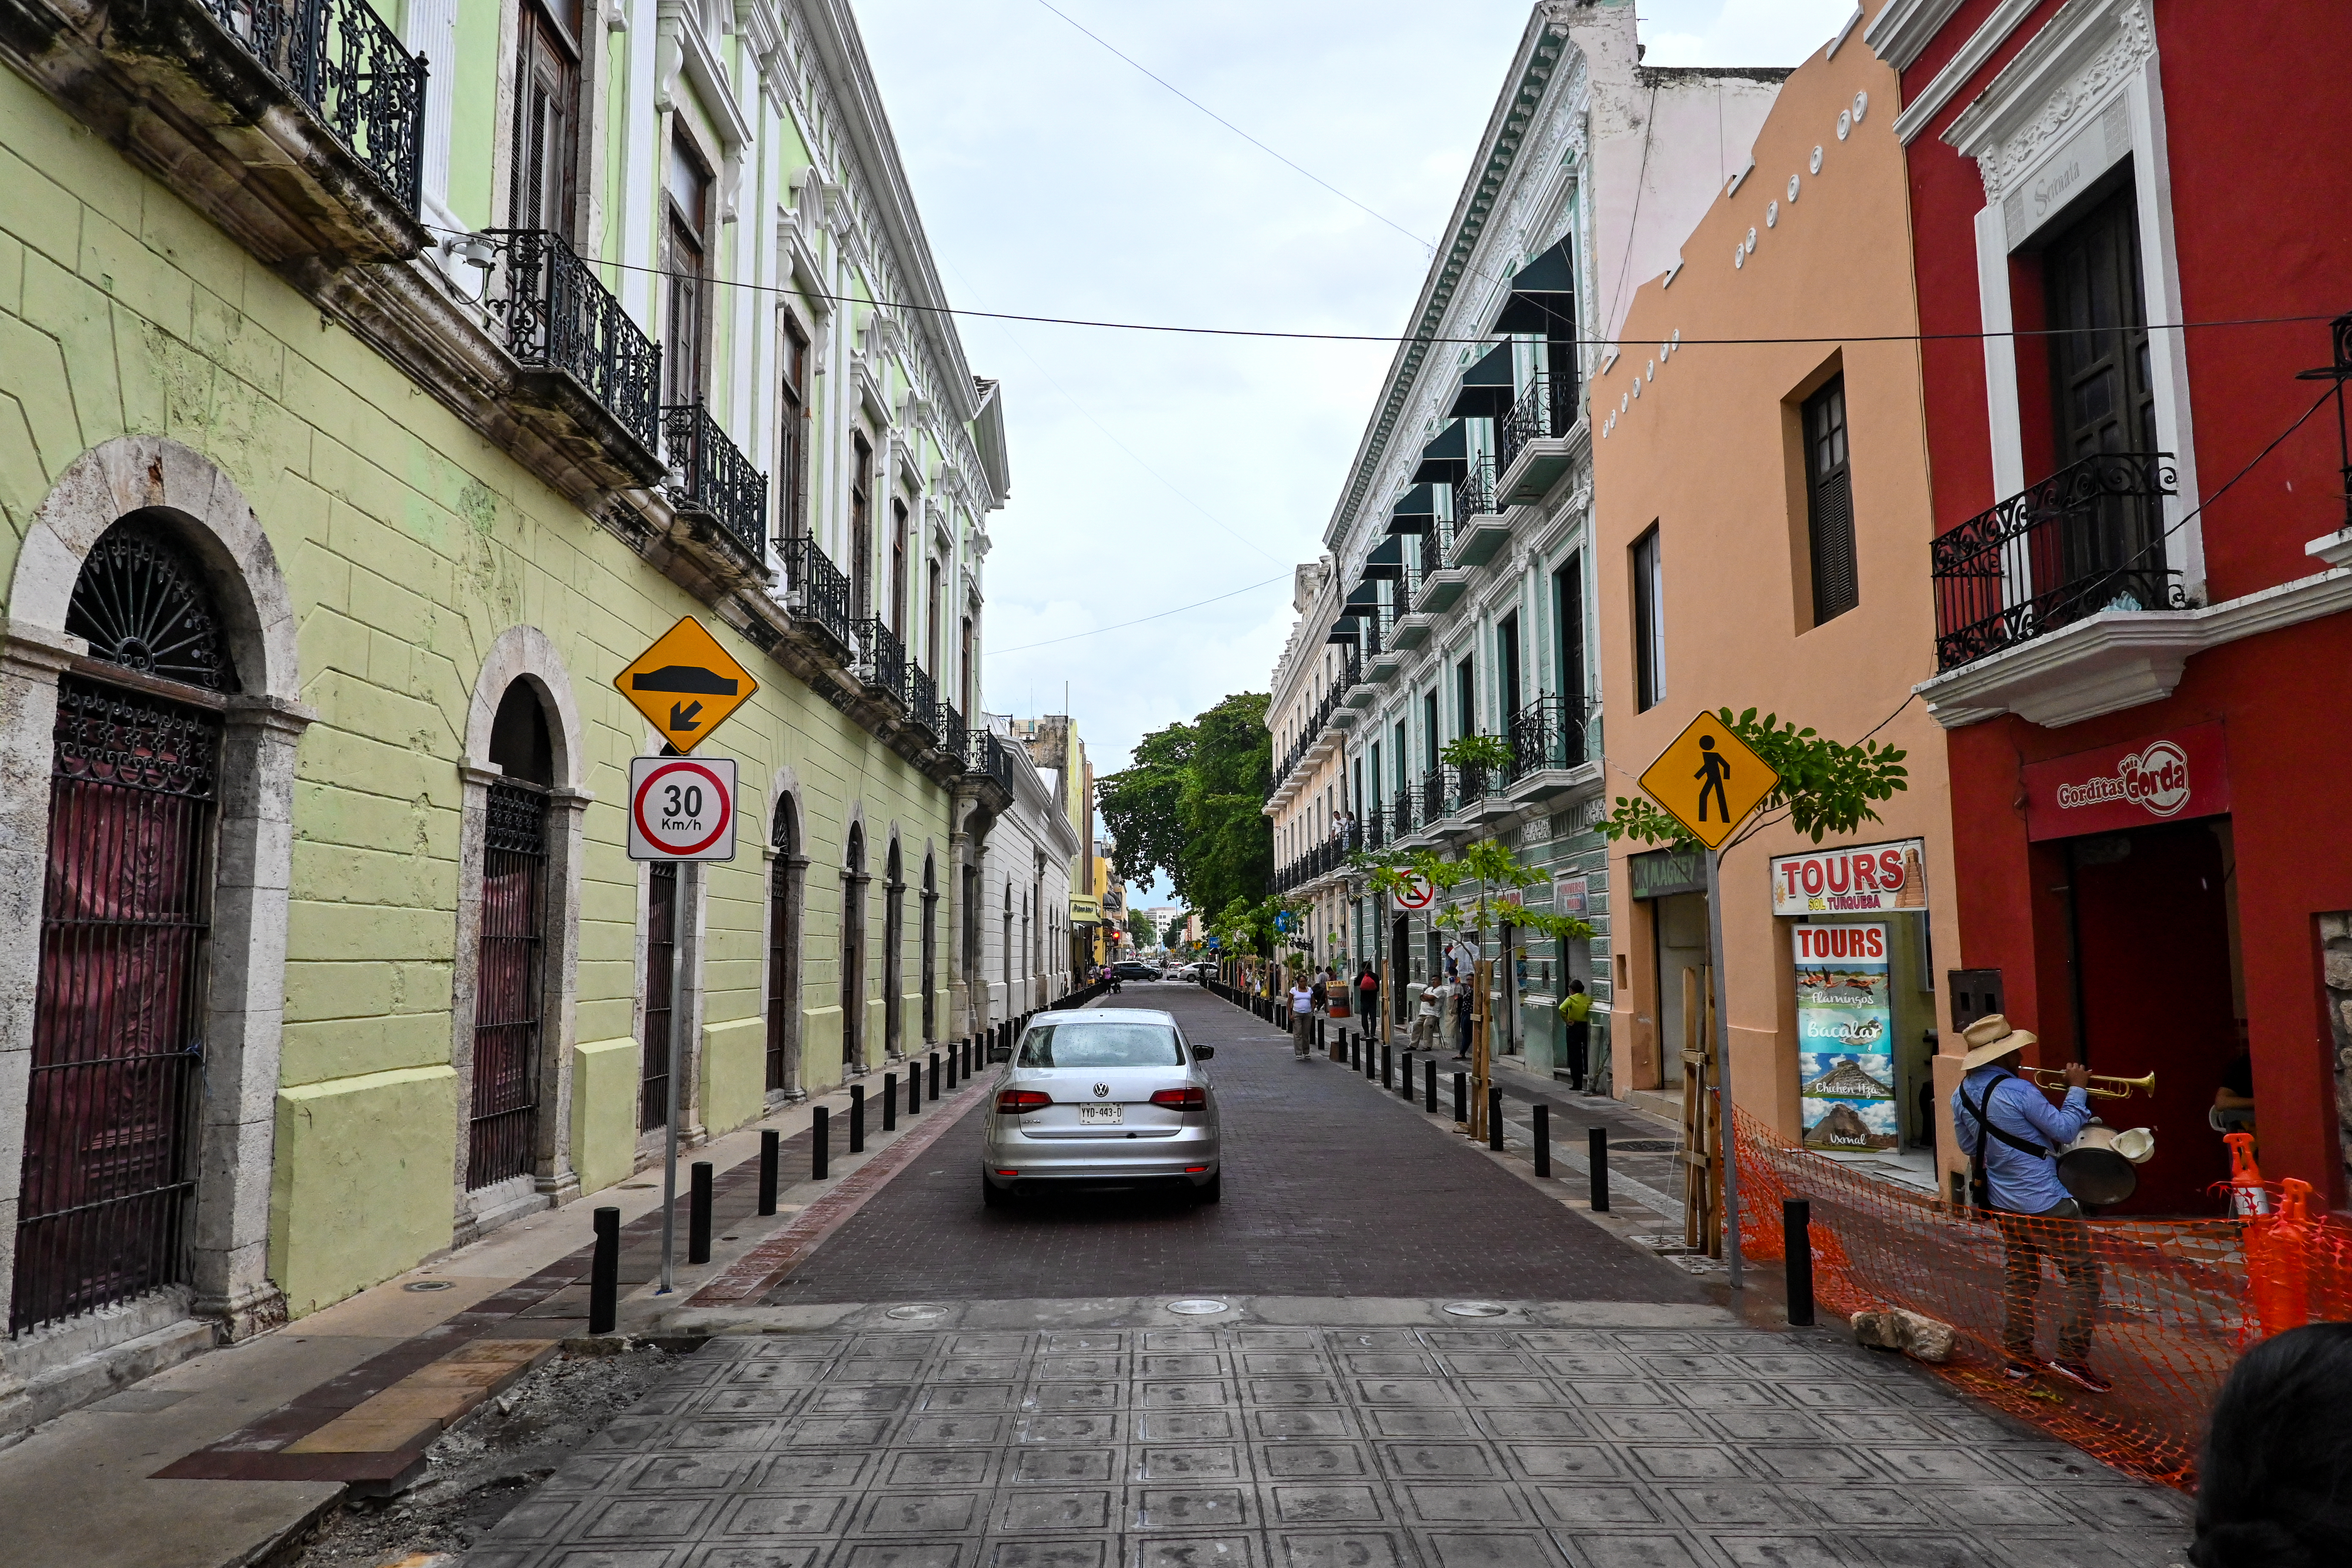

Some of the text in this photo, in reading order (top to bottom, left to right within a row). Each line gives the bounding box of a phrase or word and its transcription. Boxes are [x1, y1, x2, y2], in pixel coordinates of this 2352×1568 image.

[2059, 760, 2185, 804] Gorditas Gorda
[663, 785, 702, 817] 30
[662, 818, 701, 830] Km/h
[1781, 850, 1905, 896] TOURS
[1561, 881, 1585, 895] UNIVERSO
[1567, 898, 1580, 909] MAYA
[1808, 894, 1881, 910] SOL TURQUESA
[1797, 928, 1883, 958] TOURS
[1812, 991, 1874, 1009] Flamingos
[1808, 1020, 1880, 1039] Bacalar
[1816, 1082, 1878, 1099] Chichén Itzá
[1081, 1108, 1122, 1118] YYD-443-D
[1830, 1133, 1867, 1145] Uxmal
